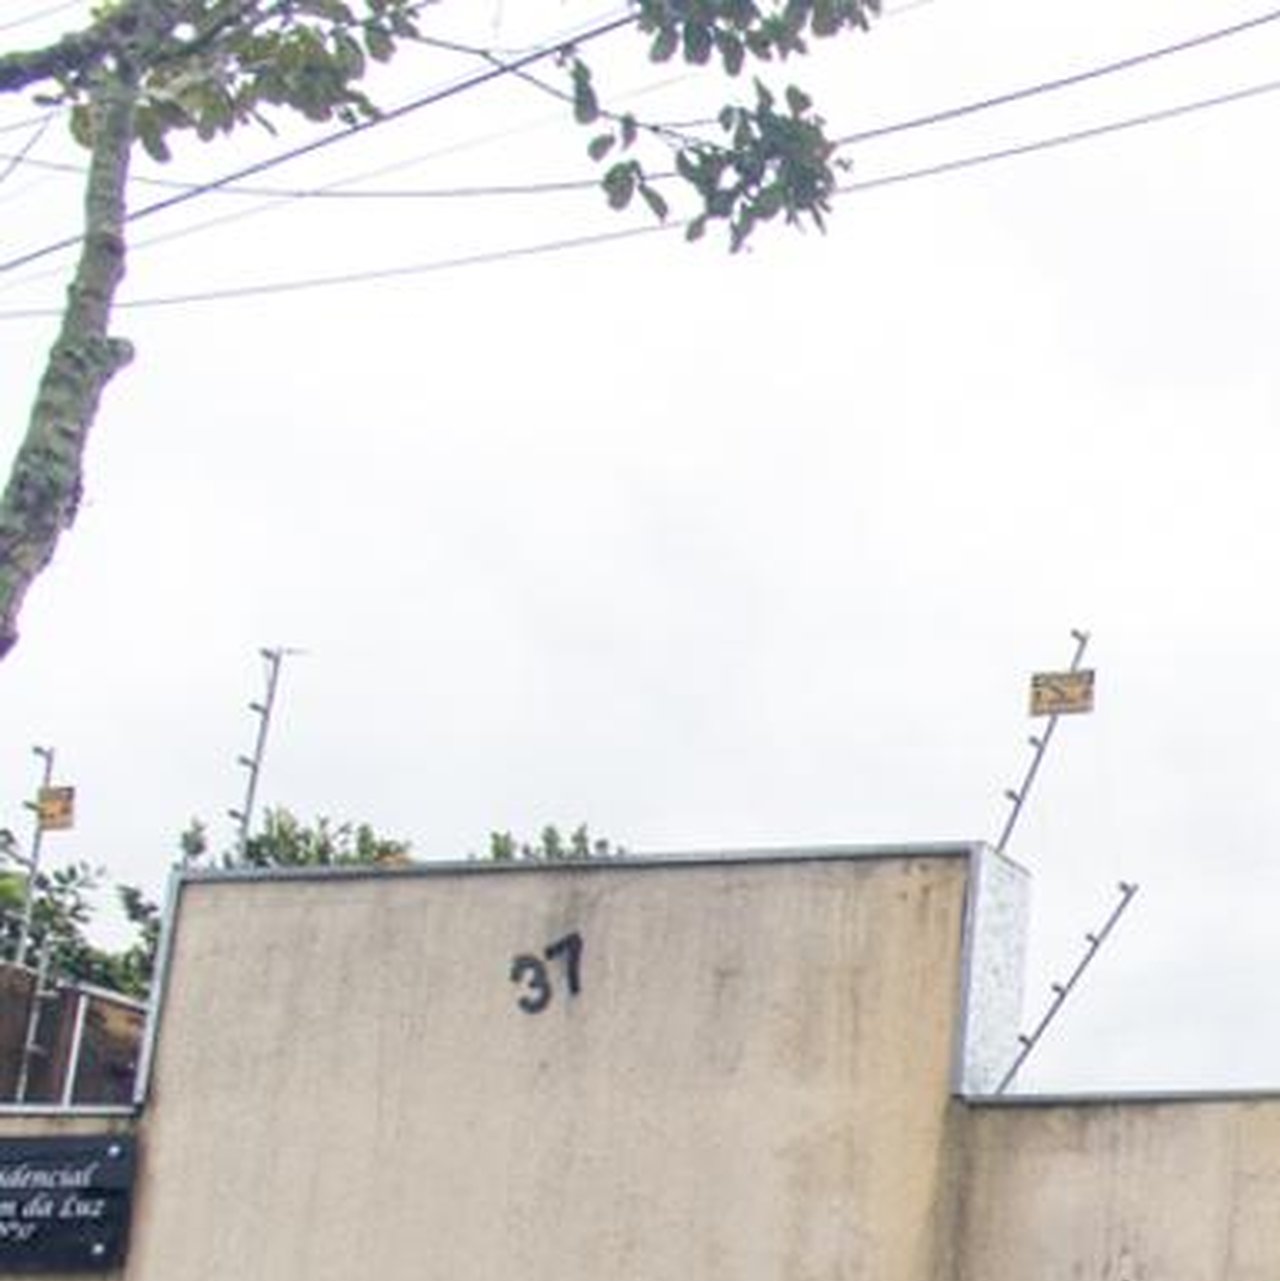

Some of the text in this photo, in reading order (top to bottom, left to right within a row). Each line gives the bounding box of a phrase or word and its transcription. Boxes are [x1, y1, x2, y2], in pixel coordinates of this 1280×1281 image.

[509, 931, 584, 1015] 37
[22, 1191, 53, 1218] da
[58, 1194, 105, 1218] Luz
